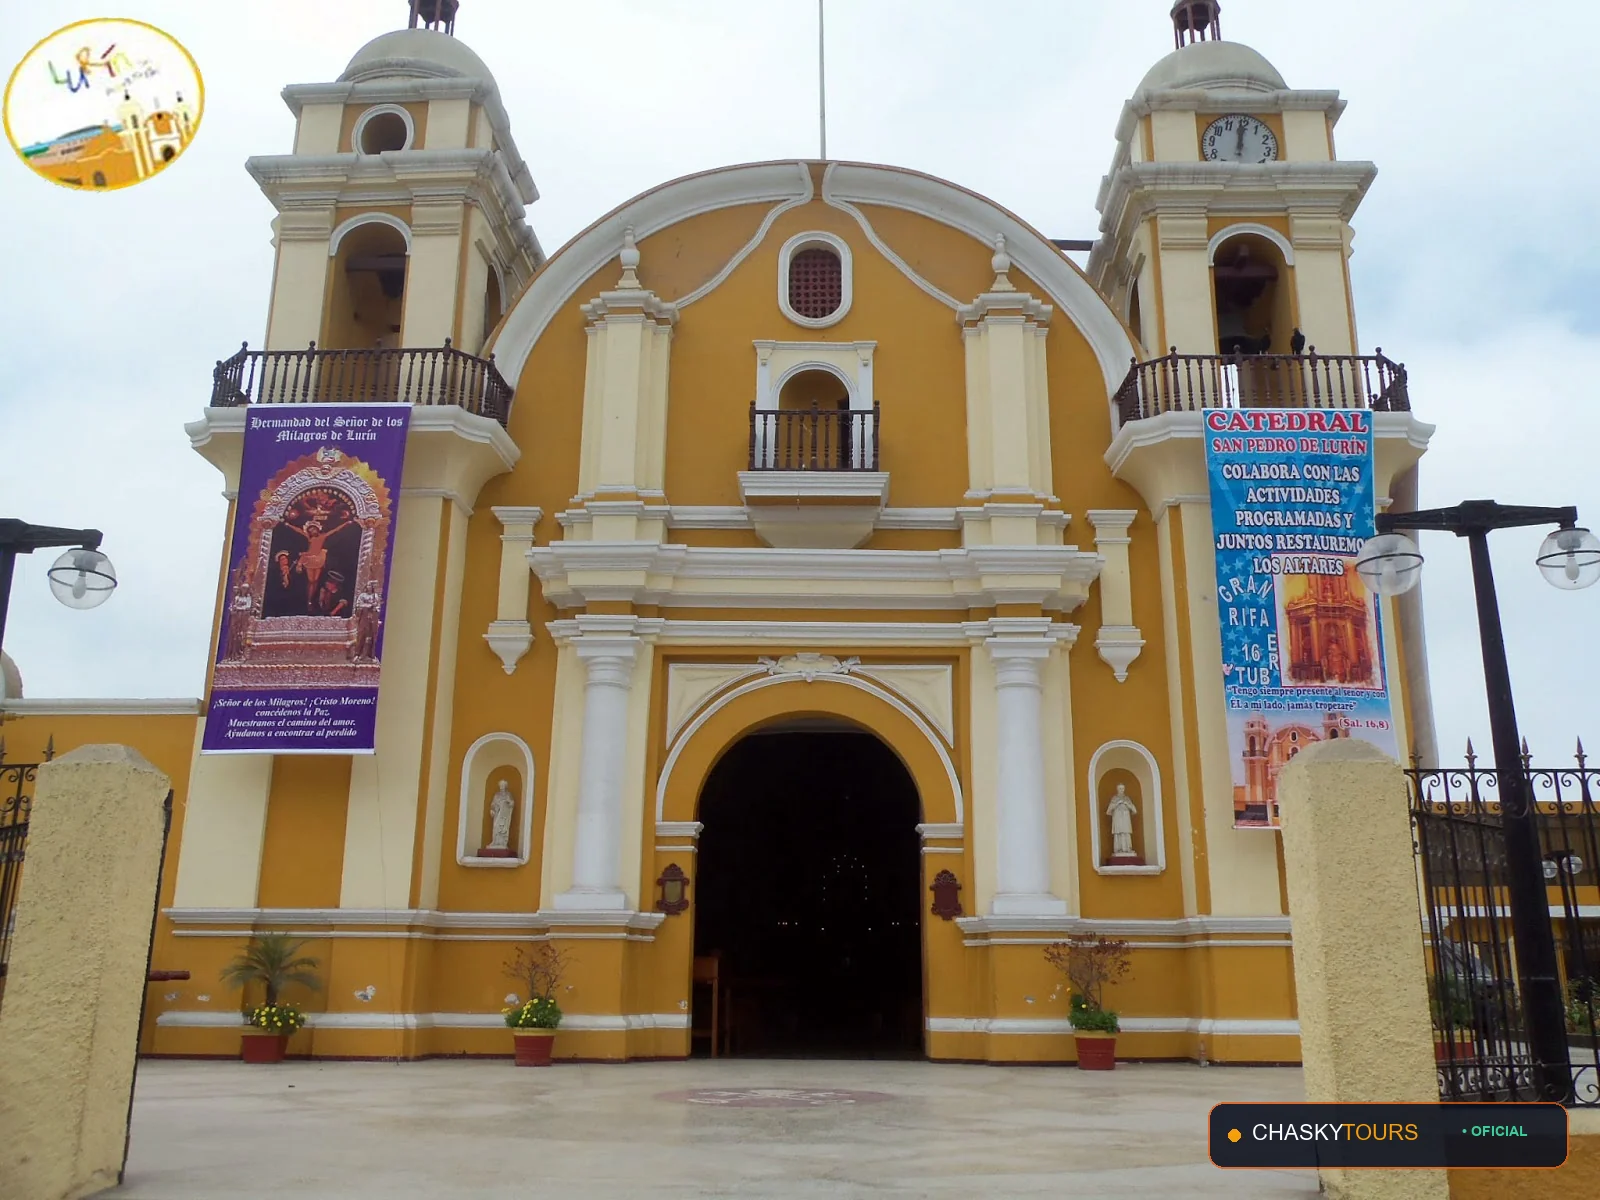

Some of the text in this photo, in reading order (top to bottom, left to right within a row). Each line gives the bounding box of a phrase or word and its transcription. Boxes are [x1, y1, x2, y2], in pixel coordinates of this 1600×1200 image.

[1214, 125, 1223, 137] 10
[1225, 120, 1233, 131] 11
[1253, 125, 1259, 135] 1
[1208, 135, 1216, 147] 9
[1262, 135, 1269, 145] 2
[1210, 149, 1218, 160] 8
[1263, 147, 1272, 157] 3
[250, 416, 403, 430] Hermandad del Señor de los
[1207, 411, 1368, 433] CATEDRAL
[276, 429, 377, 442] Milagros de Lurín
[1212, 436, 1367, 455] SAN PEDRO DE LURÍN
[1223, 464, 1359, 482] COLABORA CON LAS
[1247, 488, 1340, 504] ACTIVIDADES
[1236, 511, 1353, 528] PROGRAMADAS Y
[1217, 534, 1366, 553] JUNTOS RESTAUREMO
[1253, 557, 1344, 575] LOS ALTARES
[1219, 575, 1273, 603] GRAN
[1229, 607, 1269, 627] RIFA
[1242, 644, 1260, 661] 16
[1260, 687, 1294, 697] siempre
[1297, 687, 1332, 697] presente
[1334, 687, 1341, 696] al
[1366, 691, 1371, 699] y
[213, 697, 376, 708] ¡Señor de los Milagros! ¡Cristo Moreno!
[1287, 700, 1313, 711] jamás
[255, 707, 301, 716] concédenos
[303, 707, 311, 716] la
[227, 718, 275, 727] Muestranos
[277, 718, 286, 727] el
[287, 718, 317, 727] camino
[318, 718, 332, 726] del
[1339, 719, 1390, 730] (Sal. 16,8)
[274, 729, 314, 737] encontrar
[316, 728, 325, 737] al
[325, 728, 357, 739] perdido
